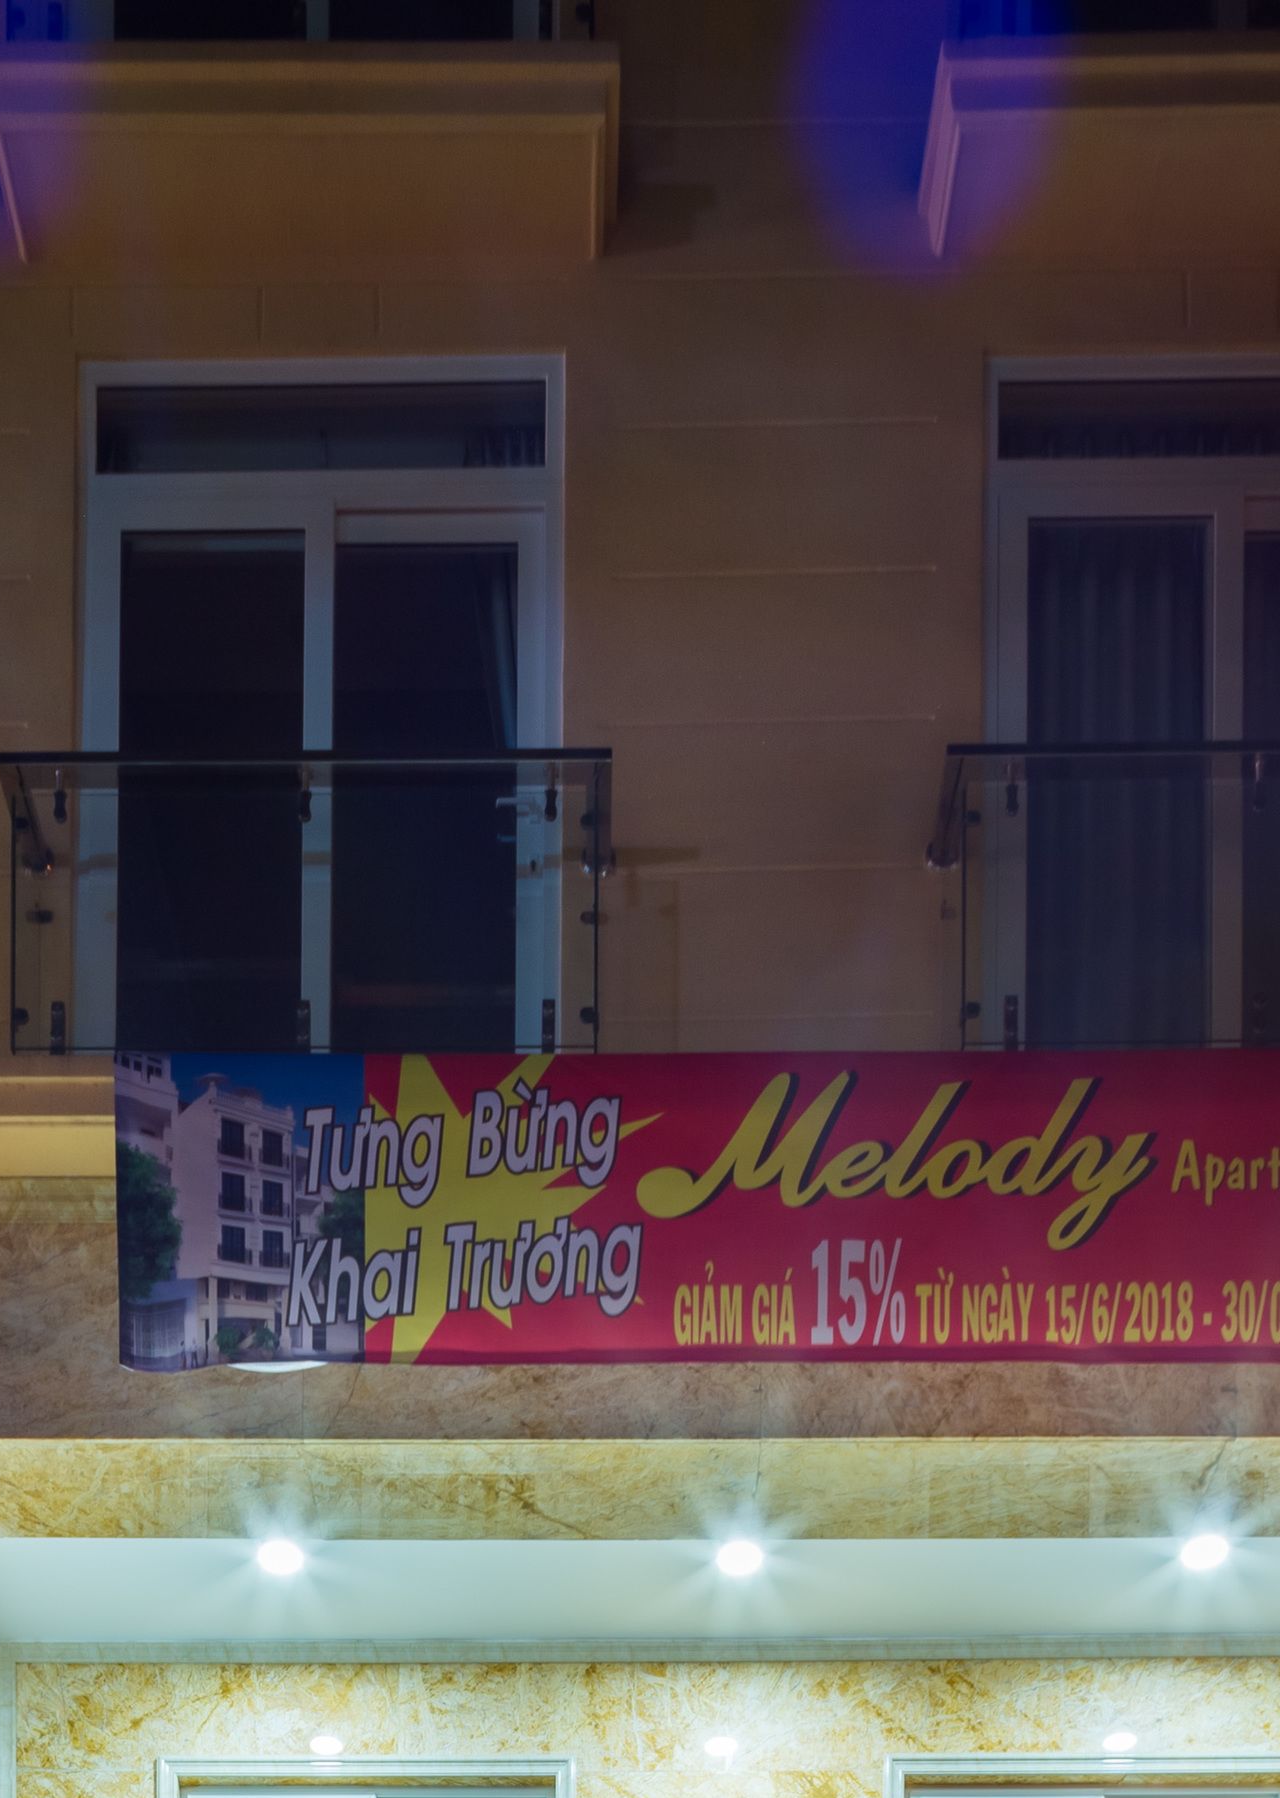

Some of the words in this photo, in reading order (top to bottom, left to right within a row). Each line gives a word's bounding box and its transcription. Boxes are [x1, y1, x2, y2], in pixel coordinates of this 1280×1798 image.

[304, 1103, 445, 1208] Tưng
[465, 1076, 621, 1188] Bừng
[636, 1069, 1158, 1251] Melody
[286, 1225, 422, 1327] Khai
[444, 1215, 643, 1317] Trương
[673, 1260, 743, 1345] GIẢM
[751, 1267, 797, 1345] GIÁ
[810, 1237, 906, 1346] 15%
[914, 1266, 955, 1345] TỪ
[961, 1266, 1035, 1344] NGÀY
[1045, 1280, 1194, 1346] 15/6/2018
